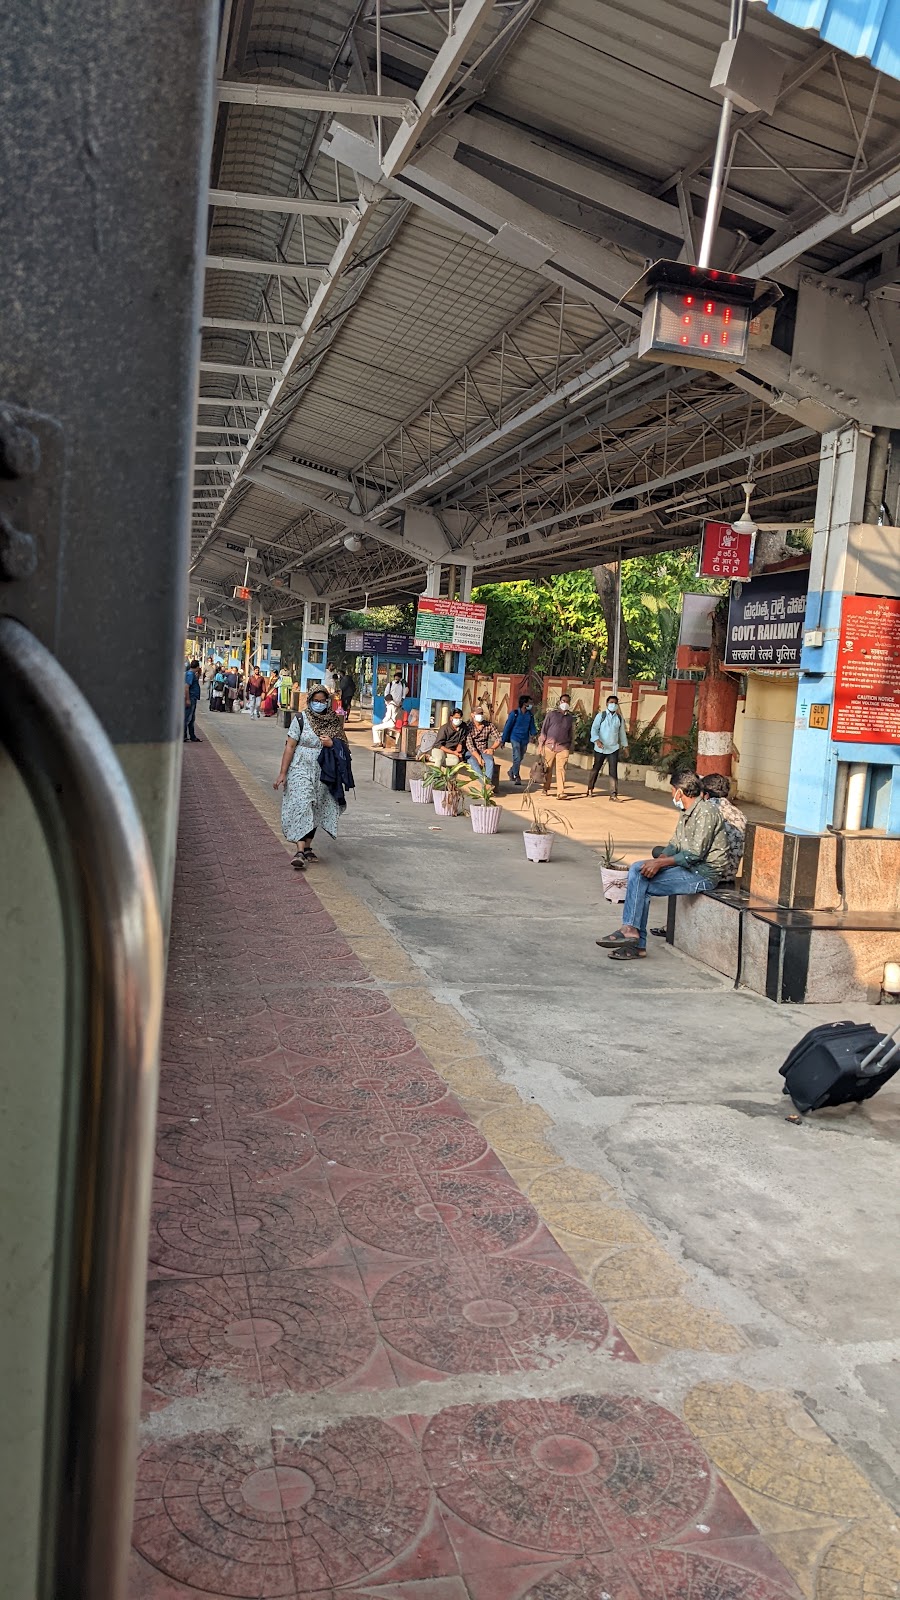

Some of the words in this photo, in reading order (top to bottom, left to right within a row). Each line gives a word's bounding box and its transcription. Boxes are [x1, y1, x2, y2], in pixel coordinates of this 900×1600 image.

[743, 600, 769, 620] ప్రభుత్వ
[770, 596, 786, 621] రైల్వే
[731, 624, 756, 642] GOVT.
[757, 622, 800, 641] RAILWAY
[731, 645, 755, 661] सरकारी
[758, 645, 773, 660] रेलवे
[776, 644, 797, 664] पुलिस
